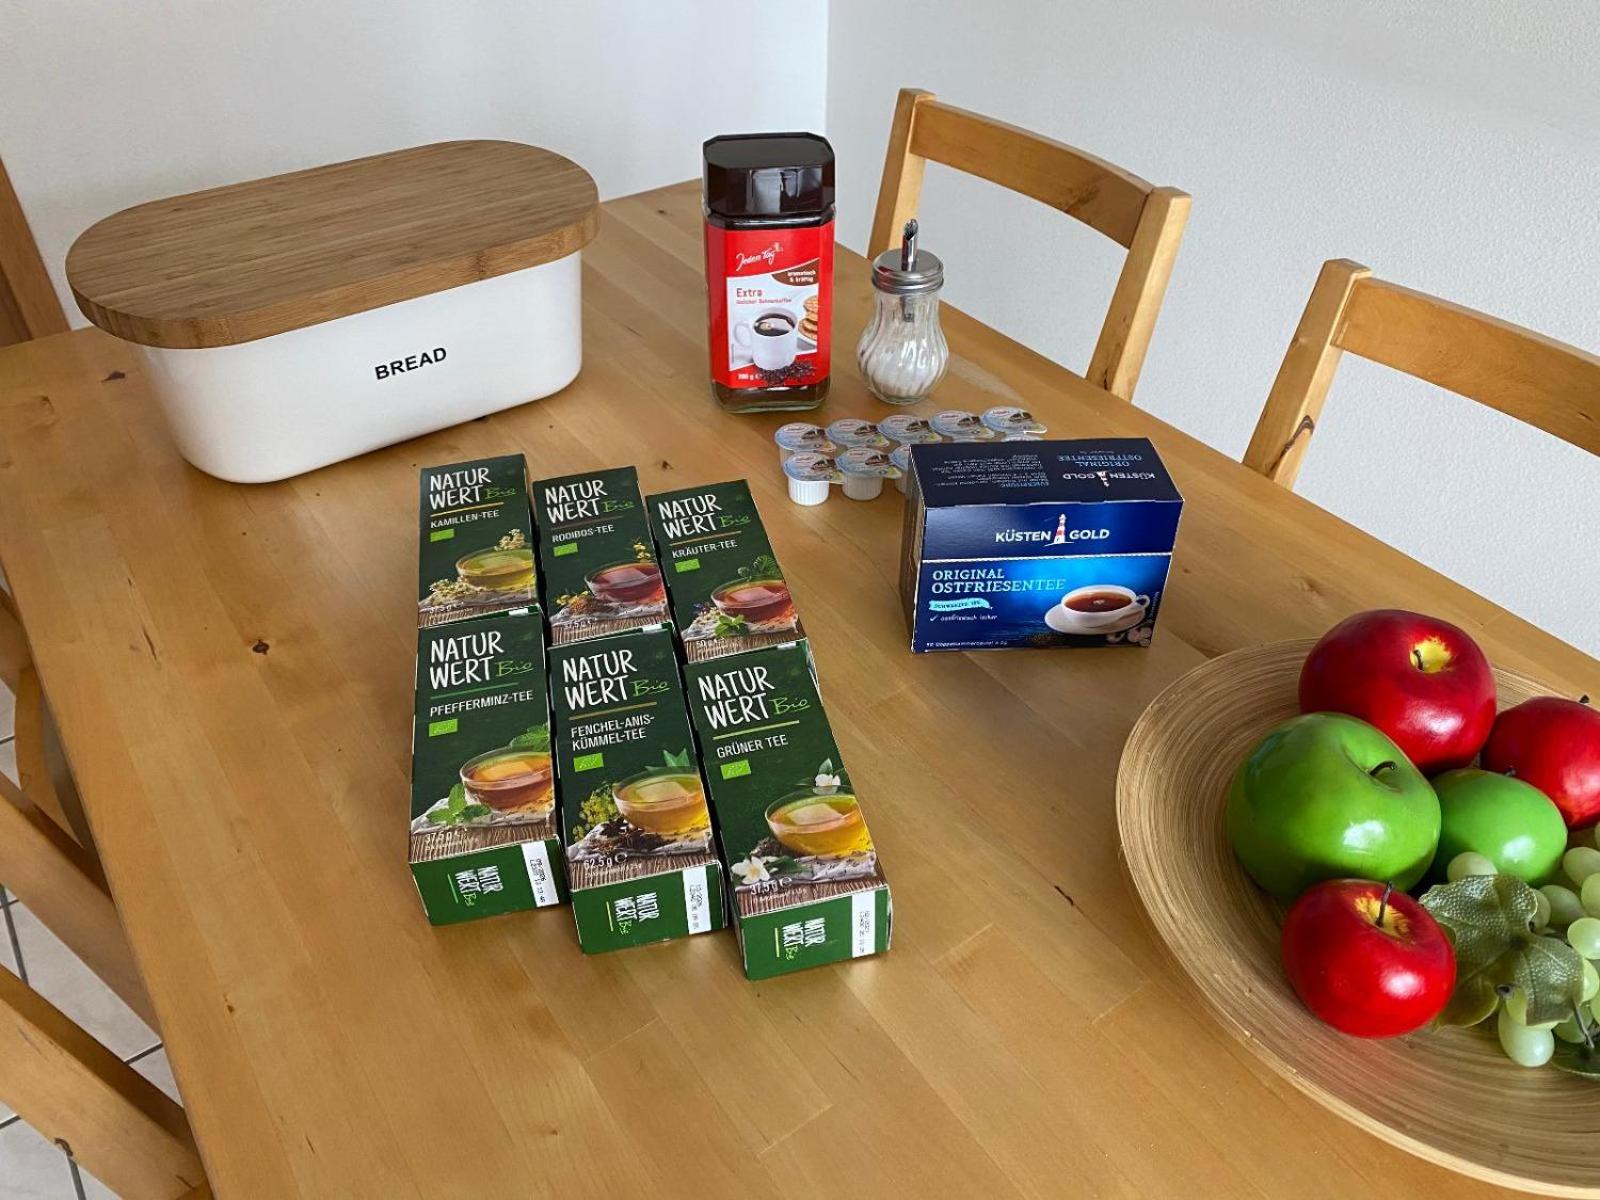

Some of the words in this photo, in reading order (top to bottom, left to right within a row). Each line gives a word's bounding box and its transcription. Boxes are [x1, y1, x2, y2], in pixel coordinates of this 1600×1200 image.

[736, 287, 763, 297] Extra
[374, 347, 447, 380] BREAD
[430, 467, 492, 491] NATUR
[1062, 472, 1096, 480] GOLD
[1109, 472, 1155, 480] KÜSTEN
[429, 484, 483, 510] WERT
[484, 487, 517, 499] Bio
[544, 479, 608, 505] NATUR
[430, 509, 500, 529] KAMILLEN-TEE
[546, 497, 600, 524] WERT
[602, 500, 635, 513] Bio
[657, 494, 722, 521] NATUR
[552, 524, 615, 543] ROOIBOS-TEE
[662, 512, 717, 539] WERT
[719, 514, 750, 528] Bio
[995, 529, 1051, 543] KÜSTEN
[1069, 529, 1110, 540] GOLD
[671, 538, 739, 559] KRÄUTER-TEE
[931, 578, 1067, 594] OSTFRIESENTEE
[932, 568, 1005, 581] ORIGINAL
[431, 630, 504, 663] NATUR
[429, 656, 494, 690] WERT
[495, 660, 534, 677] Bio
[562, 649, 638, 683] NATUR
[564, 675, 629, 711] WERT
[630, 679, 671, 697] Bio
[698, 666, 775, 701] NATUR
[430, 690, 534, 717] PFEFFERMINZ-TEE
[704, 692, 769, 730] WERT
[770, 697, 811, 715] Bio
[570, 713, 656, 738] FENCHEL-ANIS-
[572, 728, 647, 751] KÜMMEL-TEE
[716, 738, 764, 759] GRÜNER
[765, 734, 788, 748] TEE
[454, 869, 481, 894] WERT
[477, 865, 504, 895] NATUR
[614, 896, 637, 922] WERT
[636, 892, 660, 922] NATUR
[782, 922, 804, 947] WERT
[804, 917, 826, 948] NATUR
